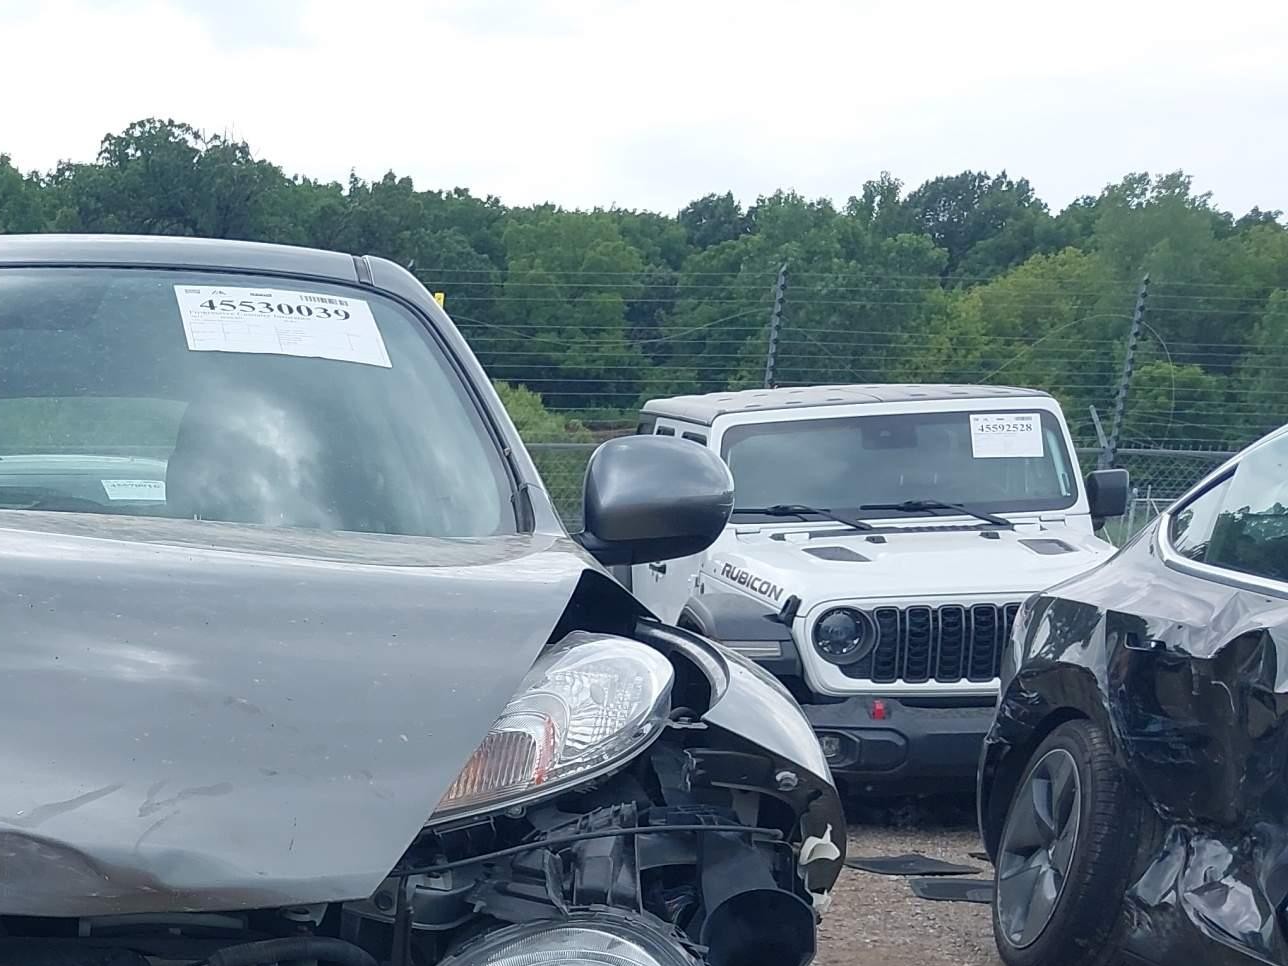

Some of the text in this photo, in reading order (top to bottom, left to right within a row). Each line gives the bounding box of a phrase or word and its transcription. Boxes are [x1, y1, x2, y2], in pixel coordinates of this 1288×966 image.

[199, 298, 351, 321] 45530039
[977, 423, 1033, 433] 45592528
[721, 562, 784, 601] RUBICON
